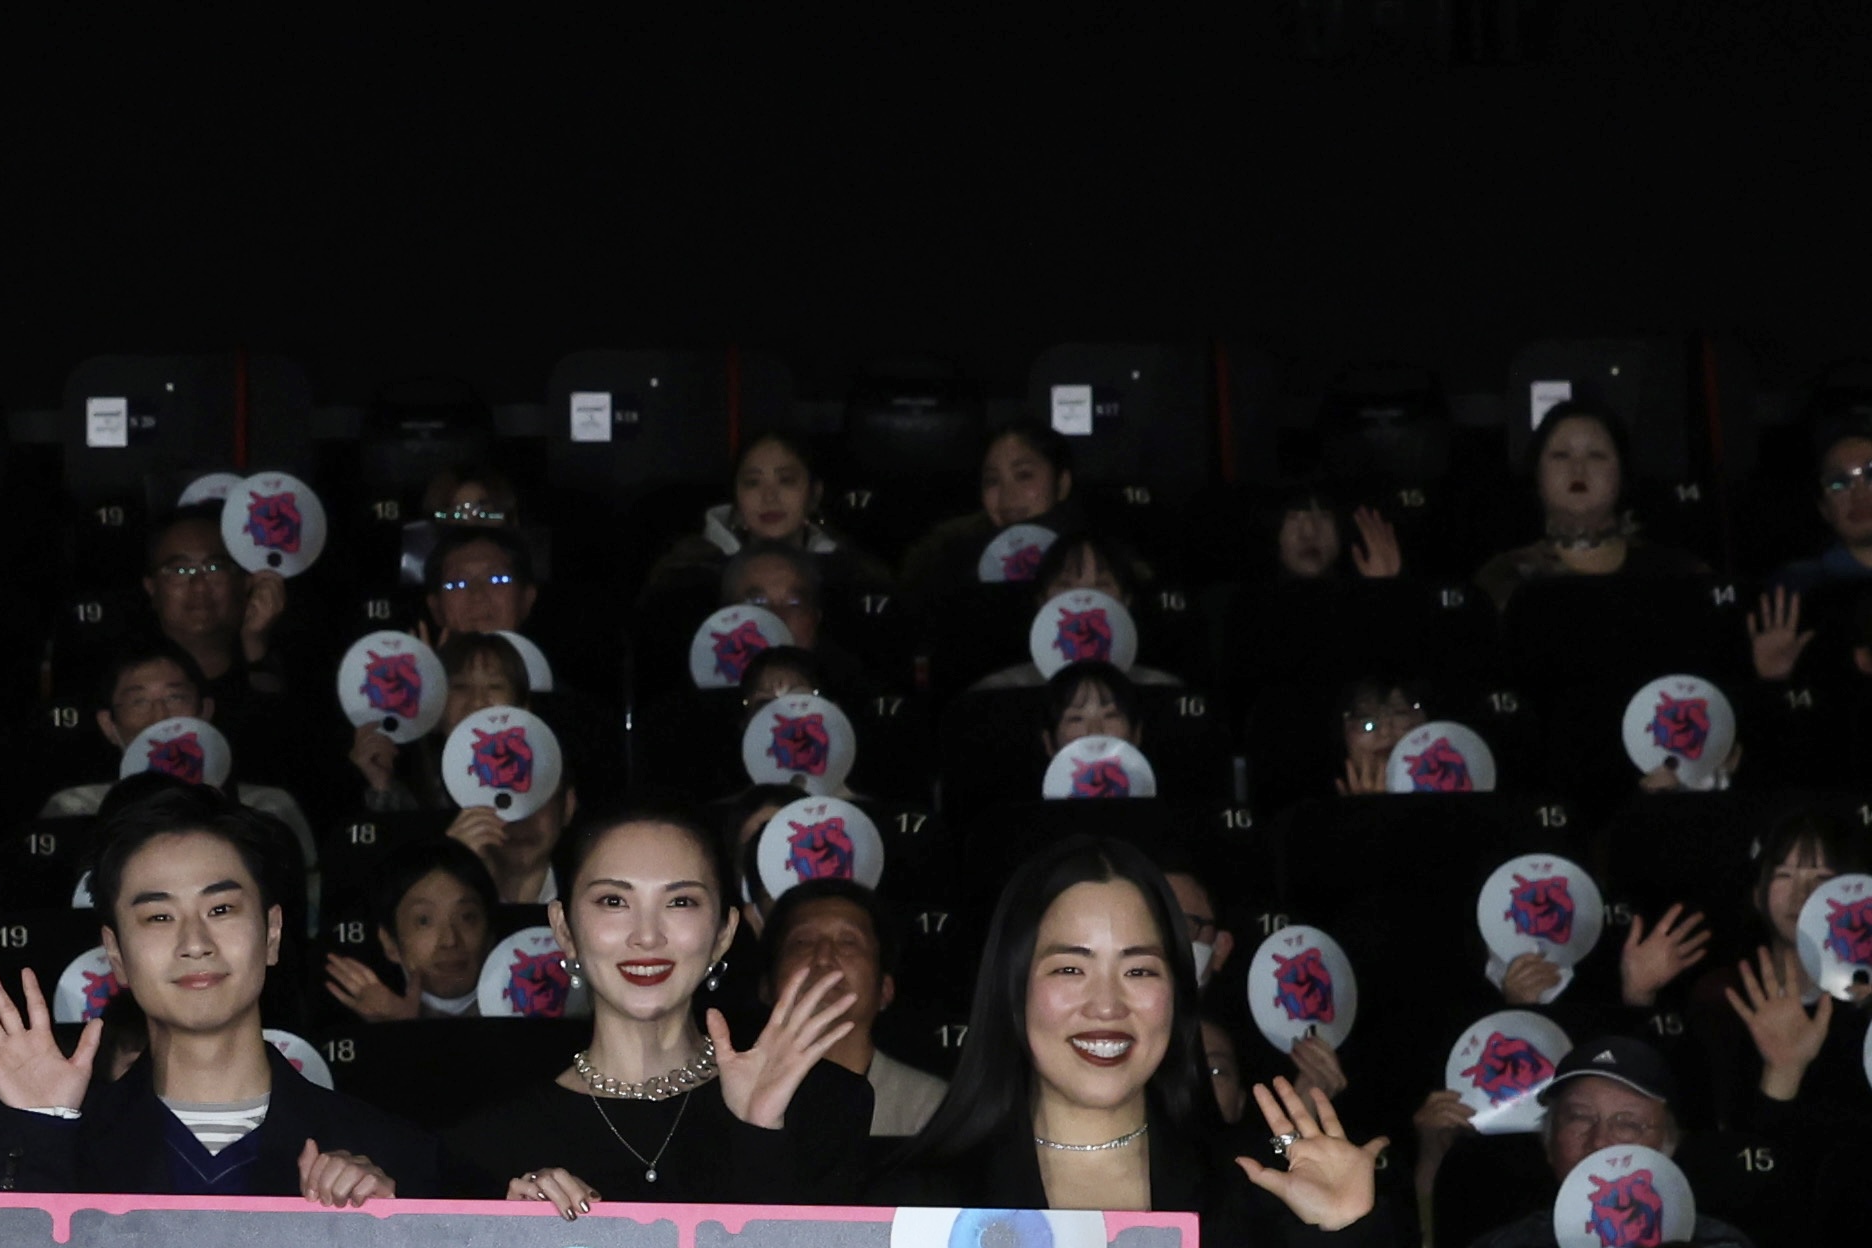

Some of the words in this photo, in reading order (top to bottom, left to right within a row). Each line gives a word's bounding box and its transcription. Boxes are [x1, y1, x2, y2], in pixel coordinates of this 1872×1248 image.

[896, 812, 927, 834] 17
[1221, 808, 1253, 829] 16
[1536, 805, 1567, 828] 15
[1858, 804, 1872, 827] 1
[28, 833, 56, 856] 19
[347, 823, 376, 845] 18
[335, 921, 365, 944] 18
[917, 911, 949, 934] 17
[939, 1024, 969, 1048] 17
[1649, 1014, 1684, 1036] 15
[322, 1040, 354, 1063] 18
[1737, 1147, 1775, 1172] 15
